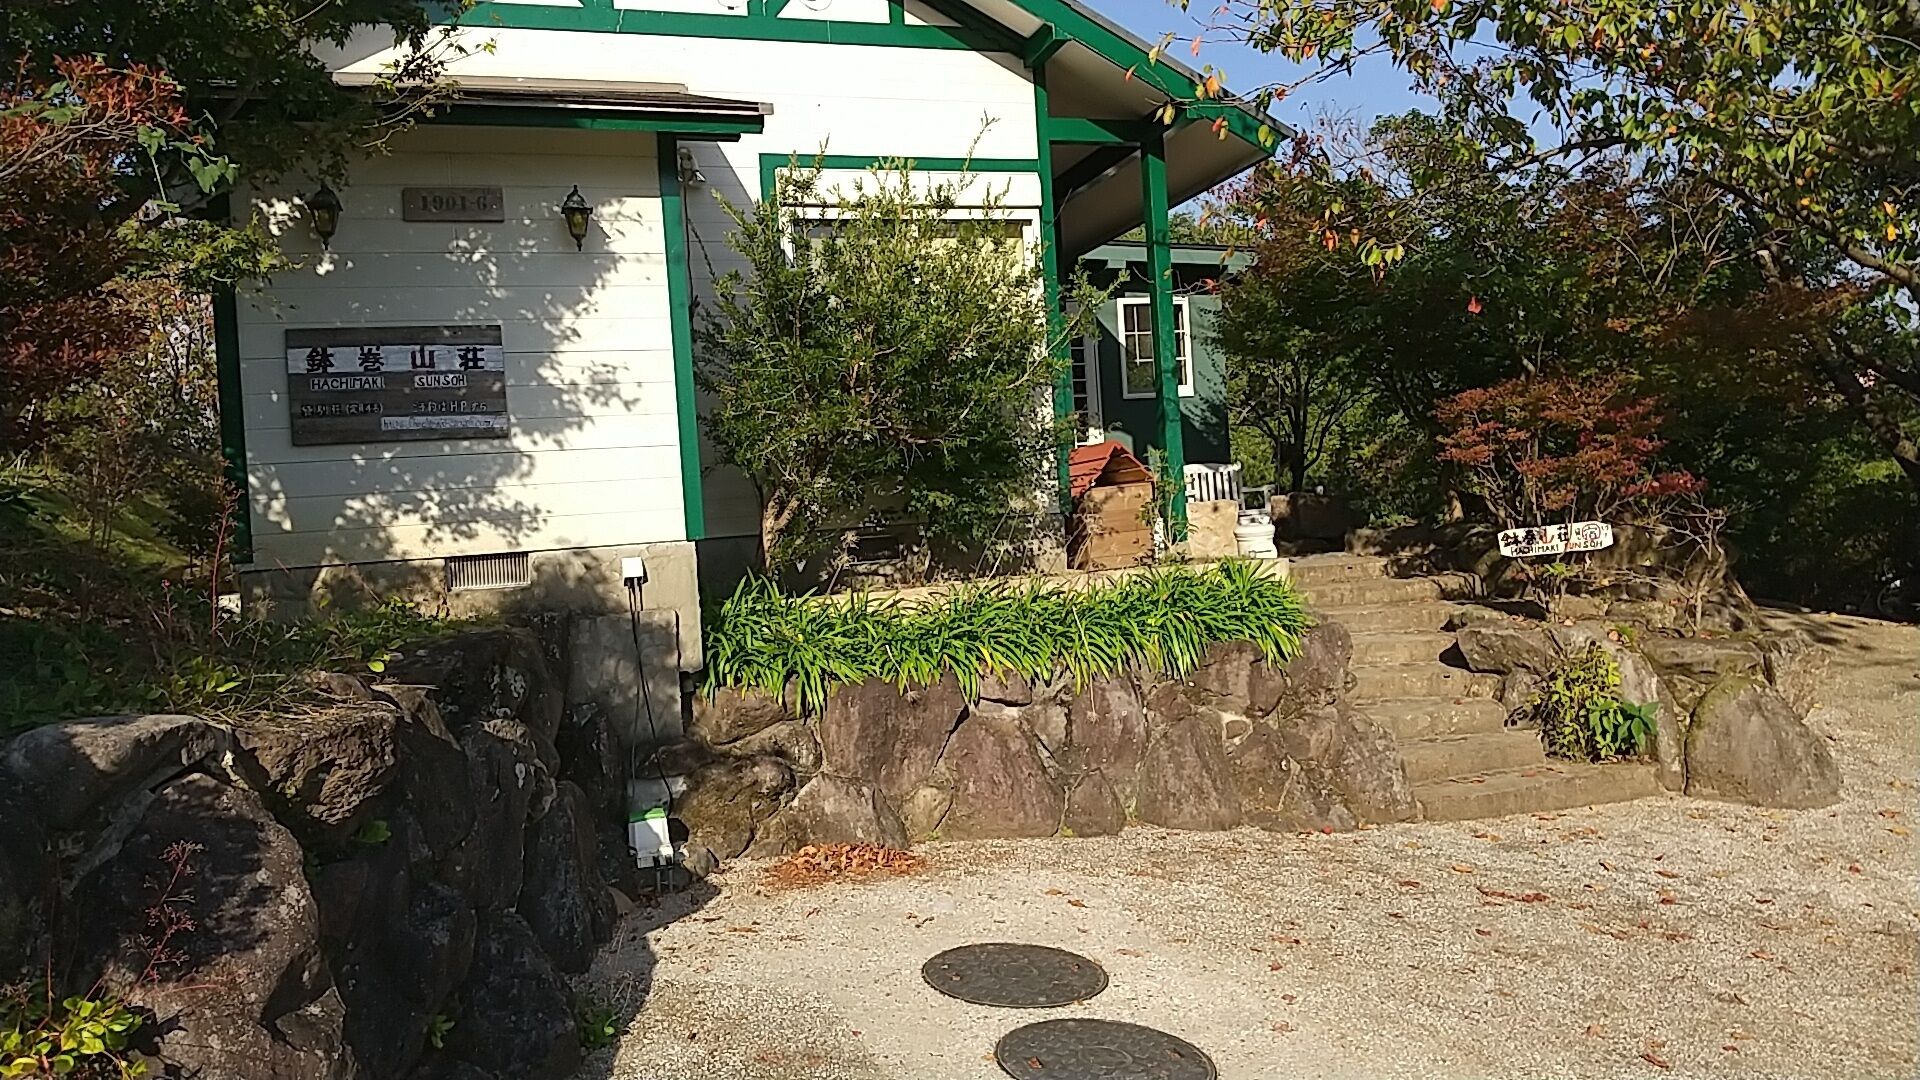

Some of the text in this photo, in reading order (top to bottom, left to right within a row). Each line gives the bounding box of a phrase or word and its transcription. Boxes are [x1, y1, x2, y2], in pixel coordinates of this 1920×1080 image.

[306, 344, 485, 373] 鉢巻山荘
[311, 375, 466, 390] HACHIMAKI SUNSOH
